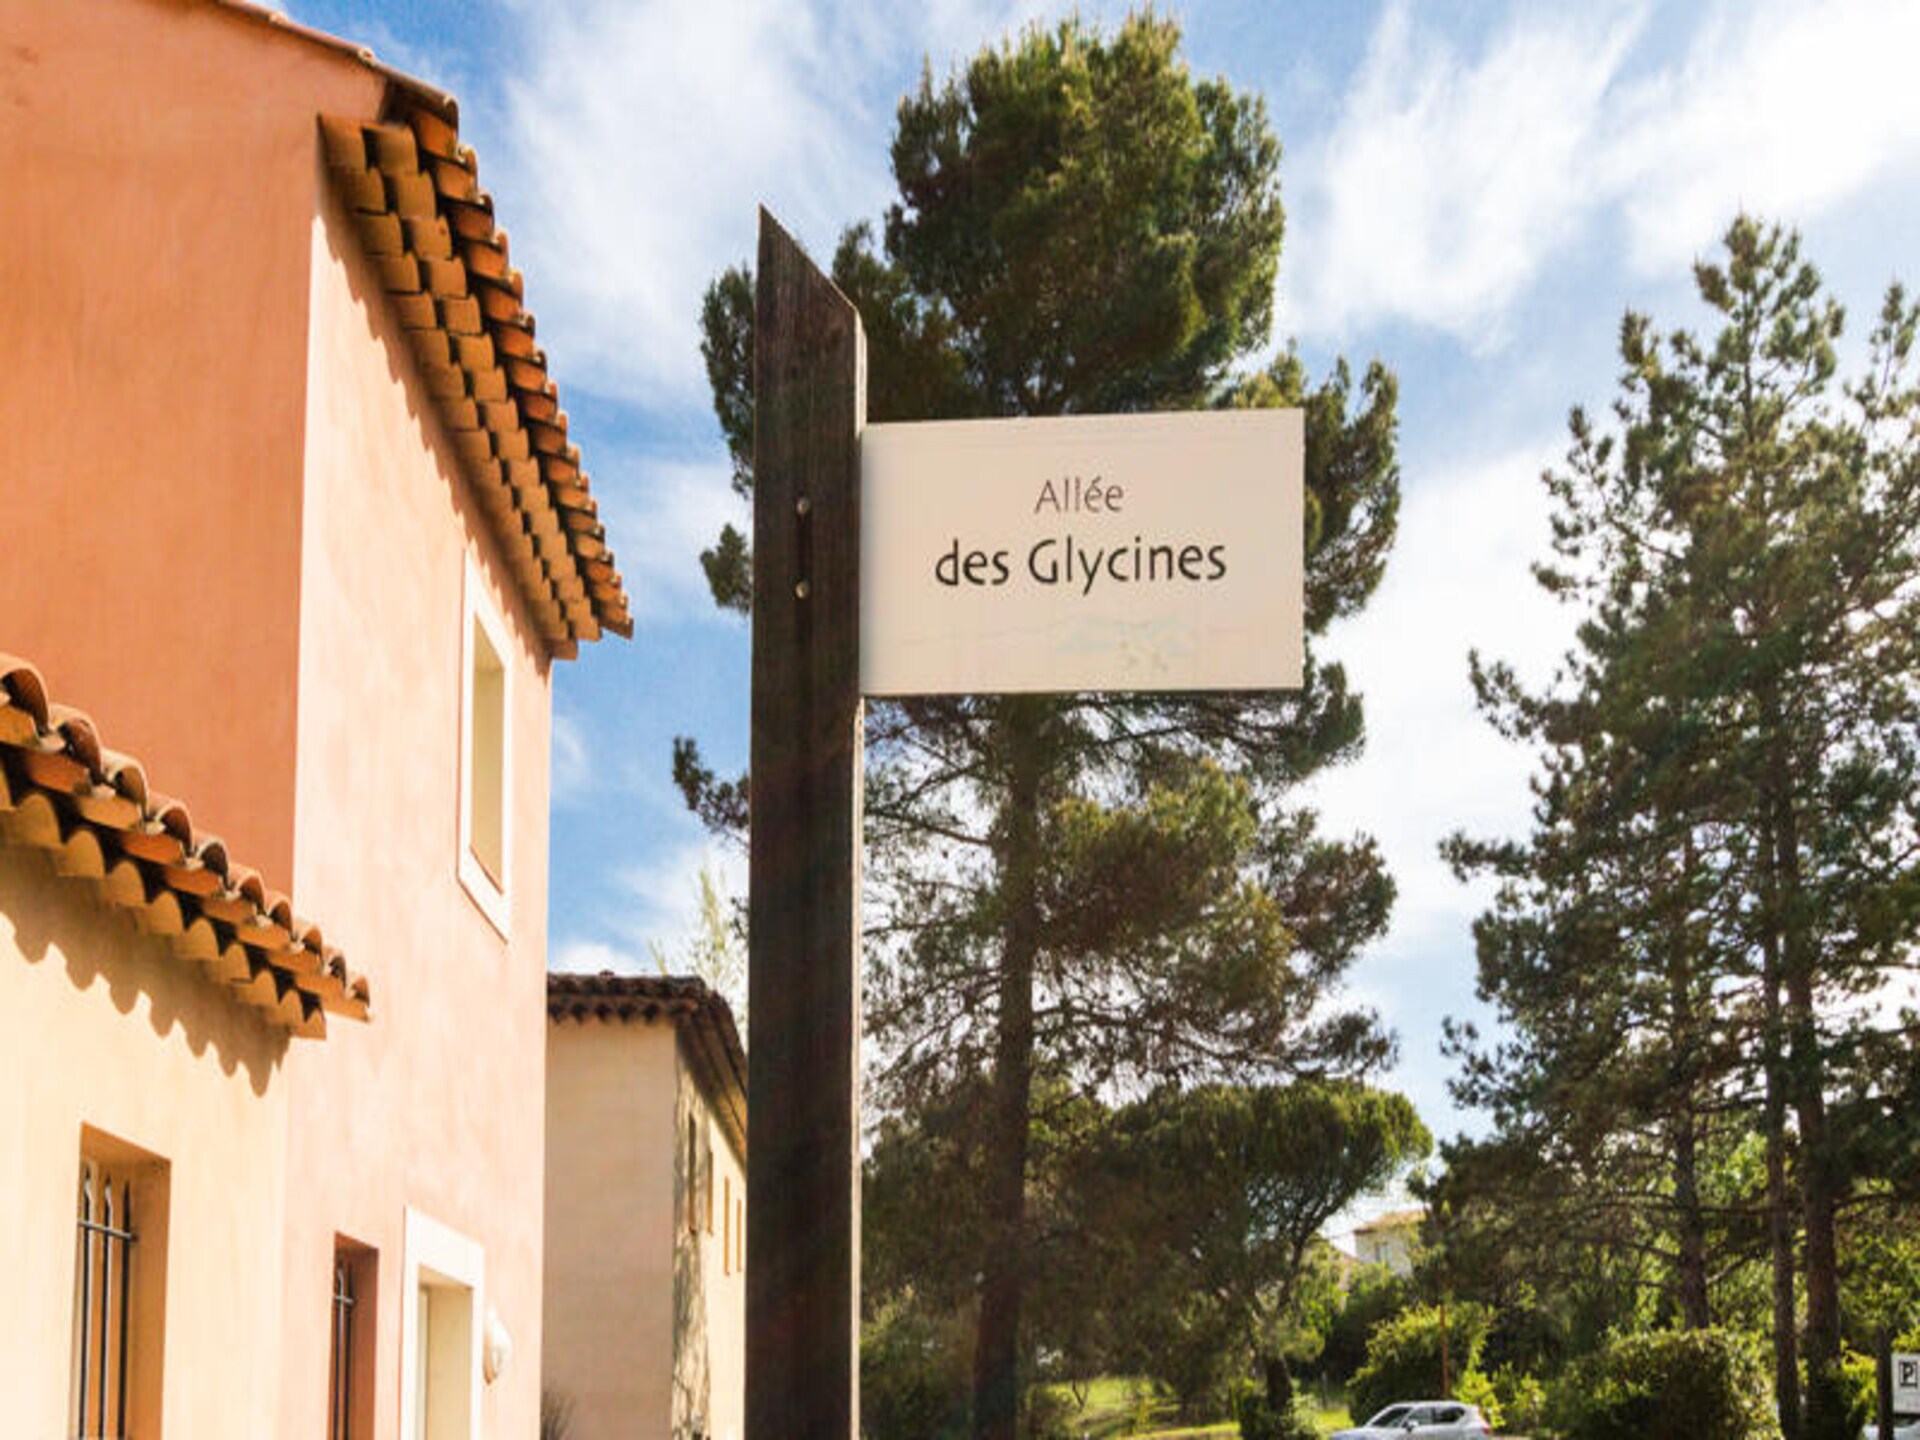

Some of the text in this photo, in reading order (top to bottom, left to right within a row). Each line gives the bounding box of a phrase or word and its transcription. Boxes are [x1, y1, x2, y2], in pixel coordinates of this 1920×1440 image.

[1034, 475, 1125, 514] Allée
[935, 535, 1227, 596] des Glycines
[1903, 1362, 1914, 1384] P
